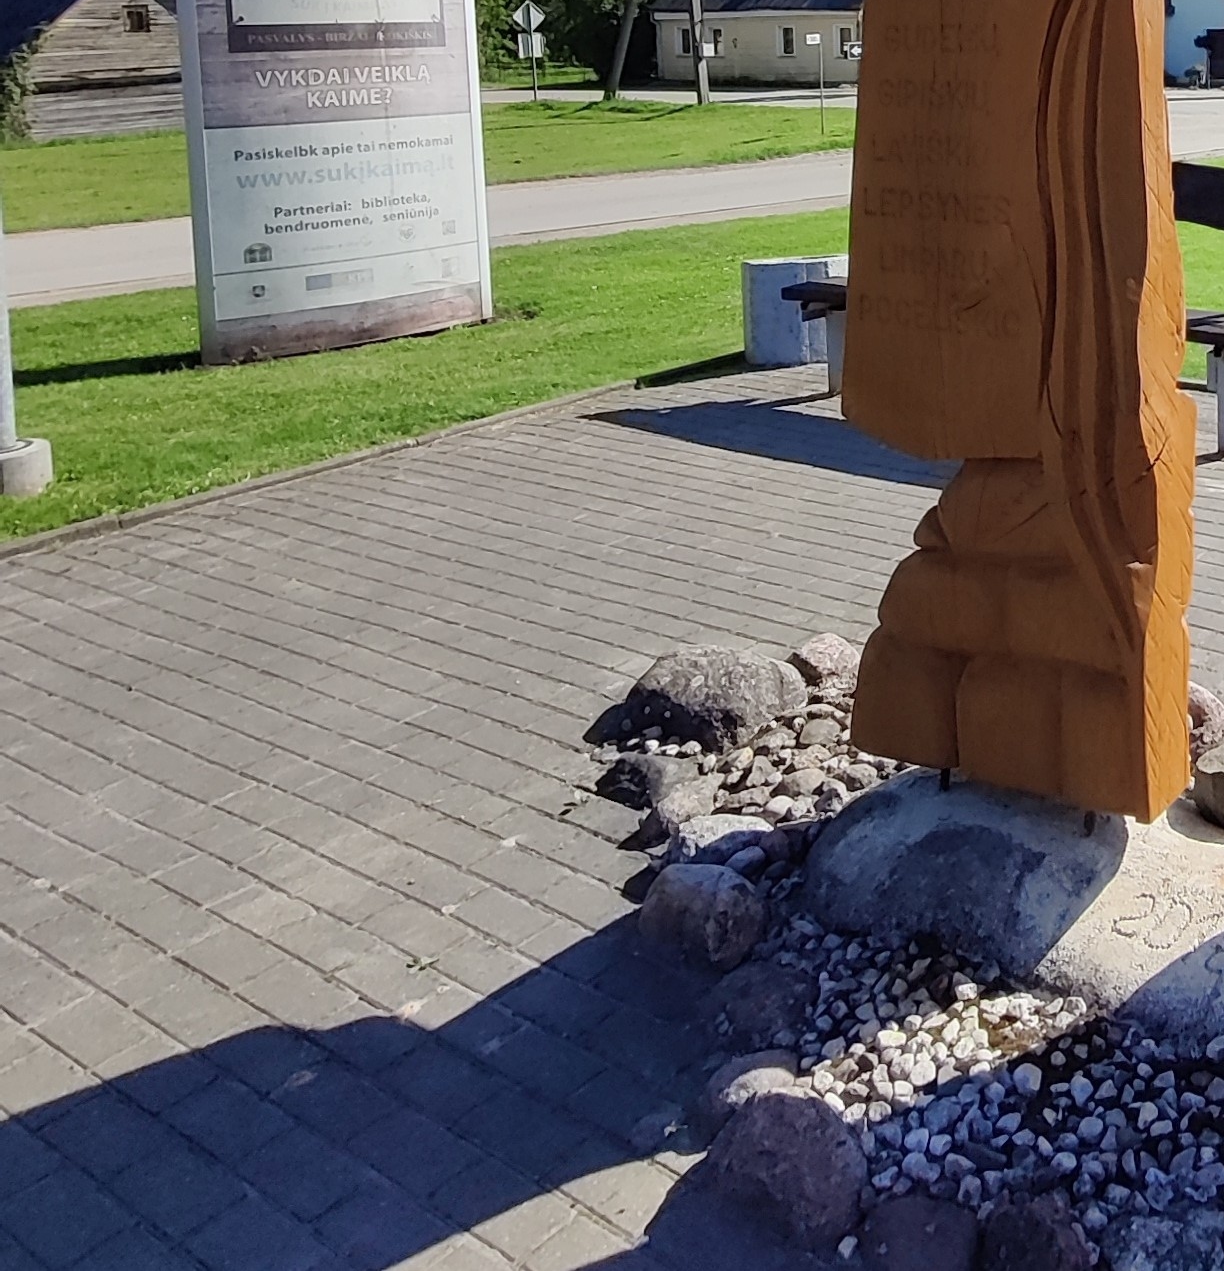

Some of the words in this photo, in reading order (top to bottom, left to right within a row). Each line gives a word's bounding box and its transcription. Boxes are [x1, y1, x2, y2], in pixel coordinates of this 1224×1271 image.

[255, 67, 350, 88] VYKDAI
[353, 65, 432, 85] VEIKLĄ
[306, 88, 393, 109] KAIME?
[233, 144, 319, 162] Pasiskelbk
[321, 141, 354, 158] apie
[356, 139, 376, 153] tai
[378, 134, 454, 150] nemokamai
[274, 200, 352, 218] Partneriai:
[361, 192, 432, 209] biblioteka,
[382, 206, 440, 223] seniūnija
